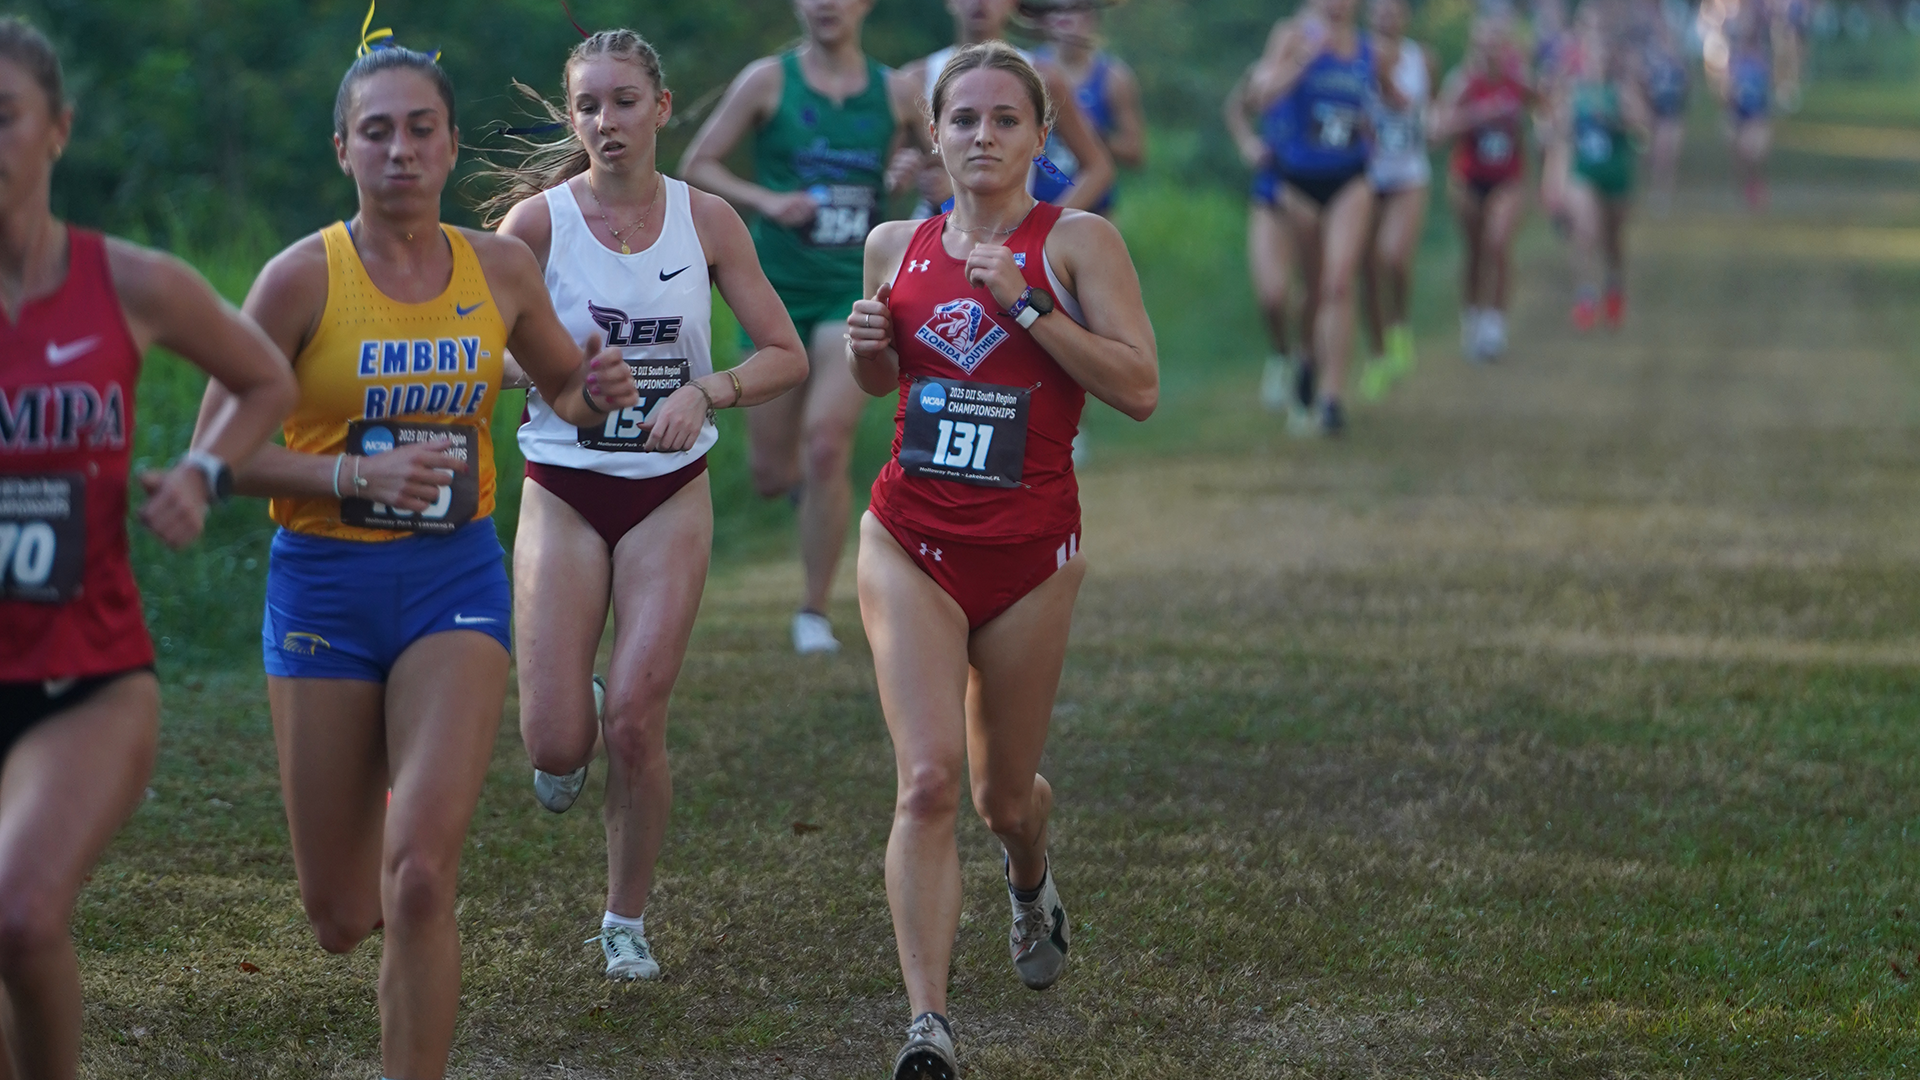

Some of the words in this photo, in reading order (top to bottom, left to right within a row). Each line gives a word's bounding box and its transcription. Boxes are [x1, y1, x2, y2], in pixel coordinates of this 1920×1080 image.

[606, 316, 683, 347] LEE
[358, 337, 491, 377] EMBRY-
[918, 327, 961, 362] FLORIDA
[961, 327, 1006, 369] SOUTHERN
[648, 366, 663, 376] South
[664, 366, 681, 377] Region
[634, 379, 681, 390] AMPIONSHIPS
[949, 387, 964, 399] 2025
[965, 389, 976, 400] DII
[976, 390, 994, 402] South
[995, 391, 1018, 406] Region
[363, 381, 488, 419] RIDDLE
[921, 396, 946, 407] NCAA
[948, 401, 1016, 419] CHAMPIONSHIPS
[604, 397, 668, 439] 15
[365, 441, 394, 451] NCAA
[399, 429, 416, 442] 2025
[932, 419, 994, 470] 131
[919, 466, 946, 475] Holloway
[0, 521, 56, 586] 70
